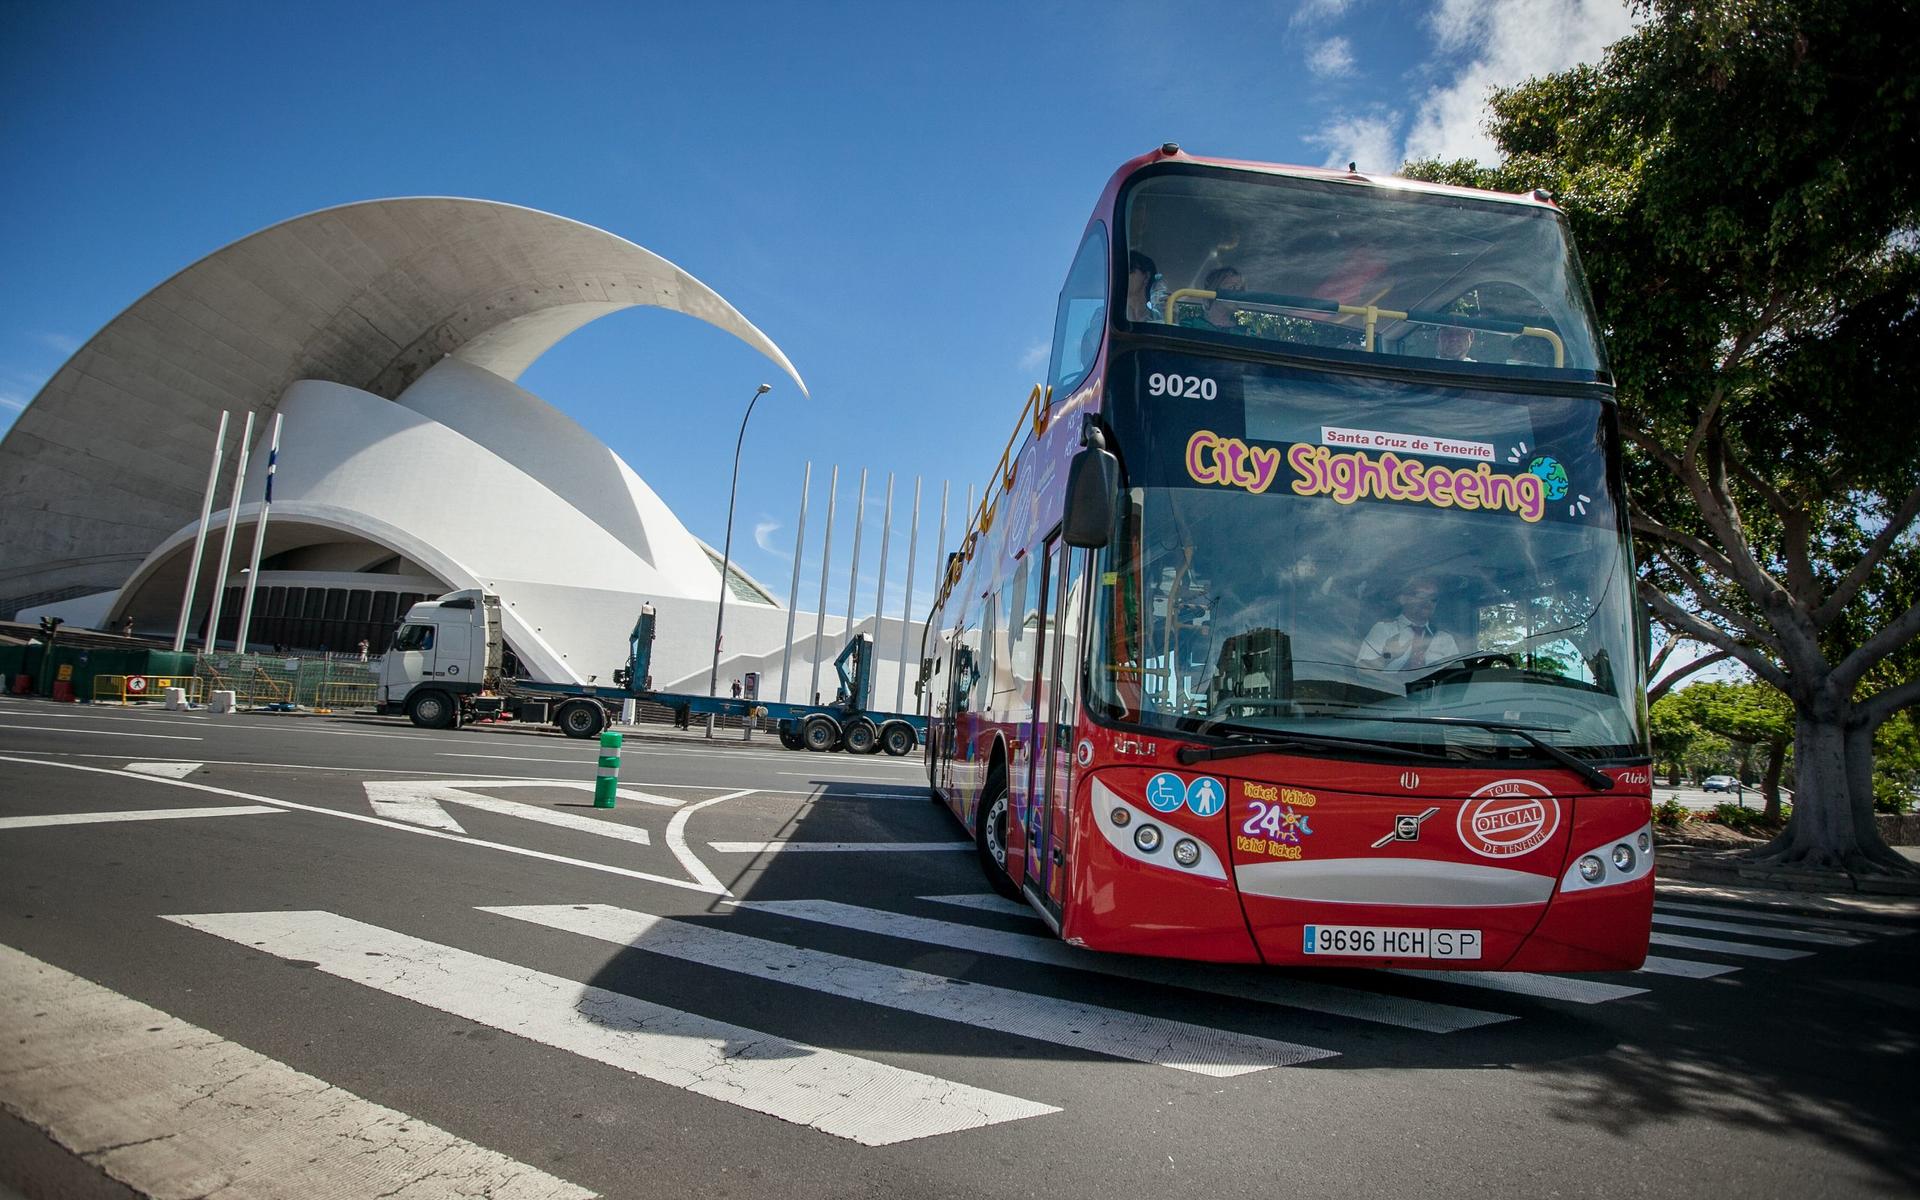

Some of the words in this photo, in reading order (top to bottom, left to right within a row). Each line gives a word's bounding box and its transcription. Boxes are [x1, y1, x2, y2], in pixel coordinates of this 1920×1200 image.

[1149, 373, 1217, 400] 9020
[1327, 430, 1369, 445] Santa
[1374, 435, 1408, 449] Cruz
[1411, 439, 1429, 450] de
[1433, 441, 1492, 458] Tenerife
[1186, 430, 1280, 494] City
[1287, 443, 1544, 523] Sightseeing
[1244, 782, 1278, 801] Ticket
[1488, 784, 1520, 797] TOUR
[1243, 801, 1280, 837] 24
[1477, 808, 1541, 831] OFICIAL
[1237, 836, 1266, 854] Valid
[1268, 841, 1302, 859] Ticket
[1483, 843, 1498, 854] DE
[1503, 830, 1547, 854] TENERIFE
[1320, 929, 1375, 951] 9696
[1383, 931, 1424, 953] HCH
